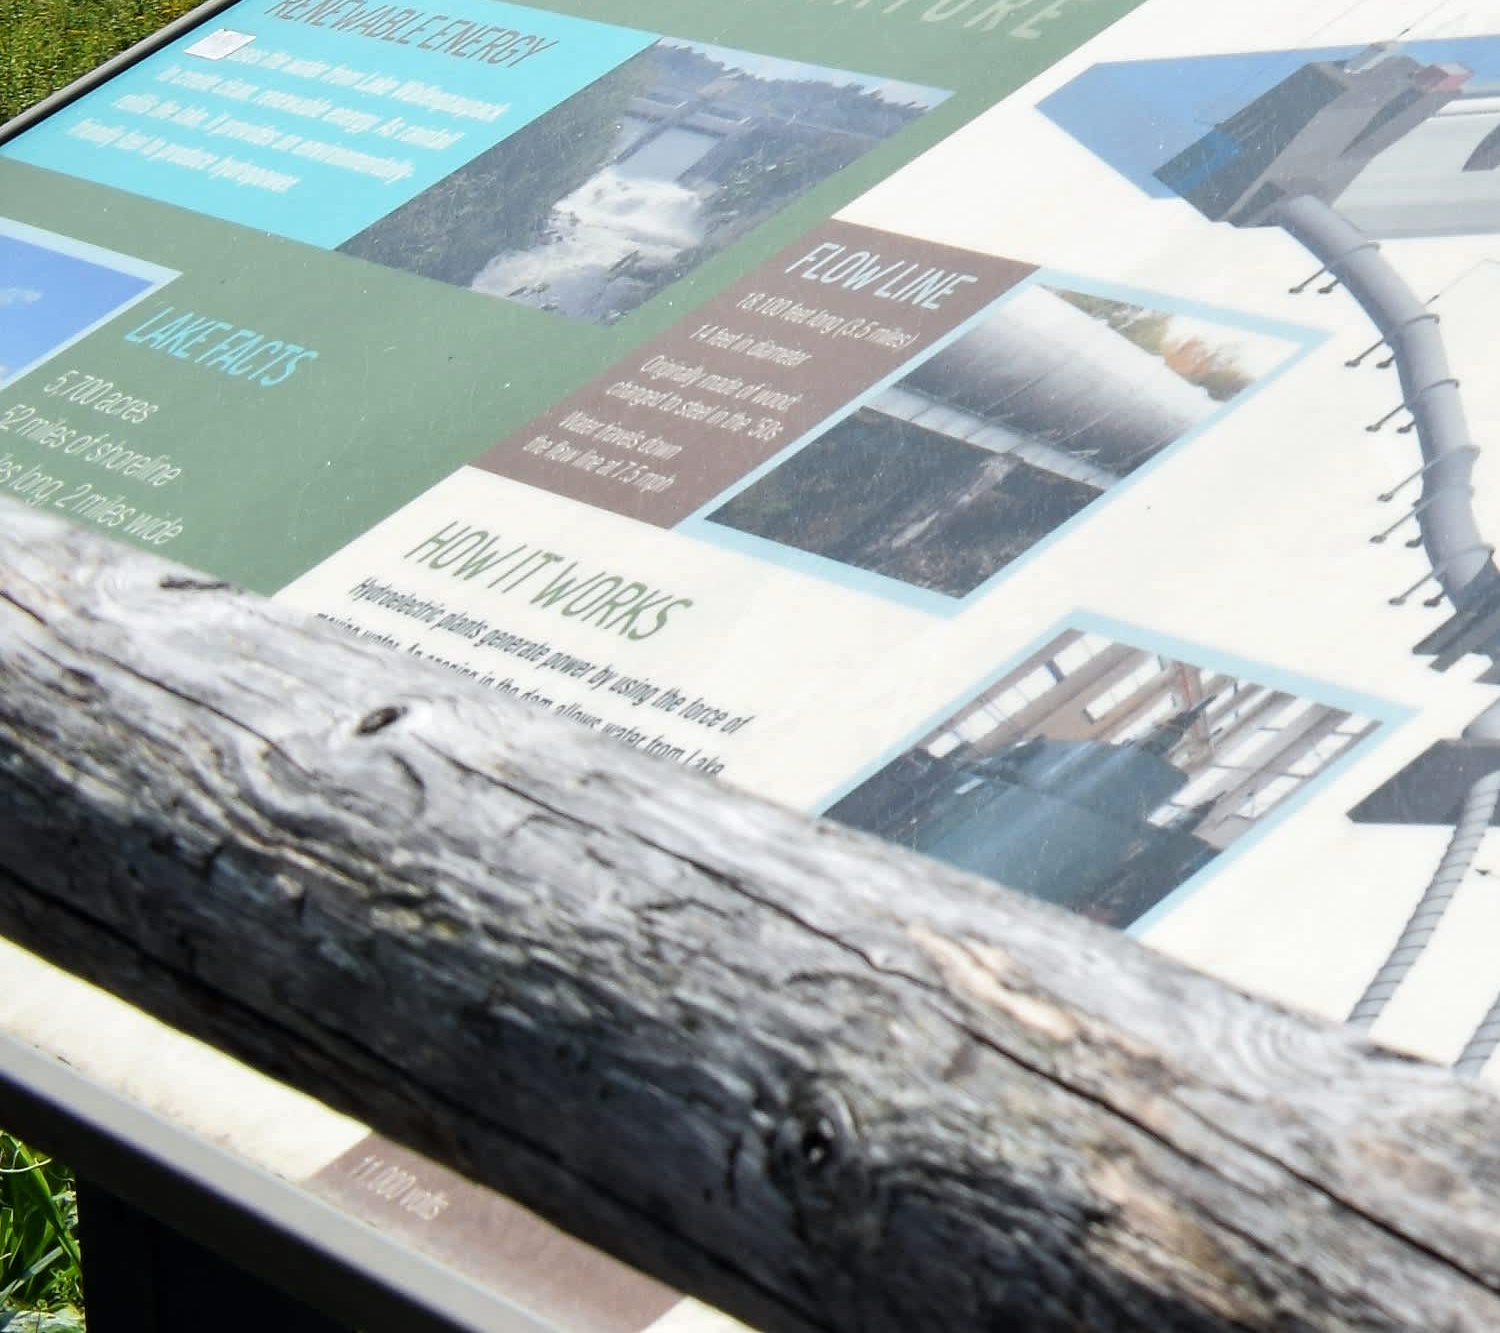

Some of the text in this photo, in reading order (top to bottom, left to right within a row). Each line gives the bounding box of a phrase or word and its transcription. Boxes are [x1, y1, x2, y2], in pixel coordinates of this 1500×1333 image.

[415, 16, 559, 68] ENERGY
[785, 242, 978, 309] FLOW LINE
[780, 303, 817, 324] feet
[806, 310, 844, 334] long
[125, 305, 319, 386] LAKE FACTS
[706, 328, 744, 349] feet
[730, 334, 758, 353] in
[746, 340, 812, 367] diameter
[44, 370, 159, 423] 5,700 acres
[640, 355, 707, 388] Originally
[696, 375, 743, 395] made
[734, 383, 765, 400] of
[606, 381, 674, 407] changed
[659, 394, 683, 411] to
[674, 401, 720, 420] steel
[16, 417, 76, 448] miles
[65, 434, 109, 454] of
[559, 411, 682, 460] Water travels down
[85, 440, 182, 486] shoreline
[523, 435, 554, 455] the
[544, 441, 582, 463] flow
[571, 449, 605, 471] line
[595, 460, 624, 476] at
[634, 472, 676, 493] mph
[55, 483, 92, 507] 2
[71, 495, 136, 527] miles
[124, 512, 183, 545] wide
[403, 521, 693, 641] HOW IT WORKS
[348, 576, 755, 734] Hydroelectric plants generate power by using the force of
